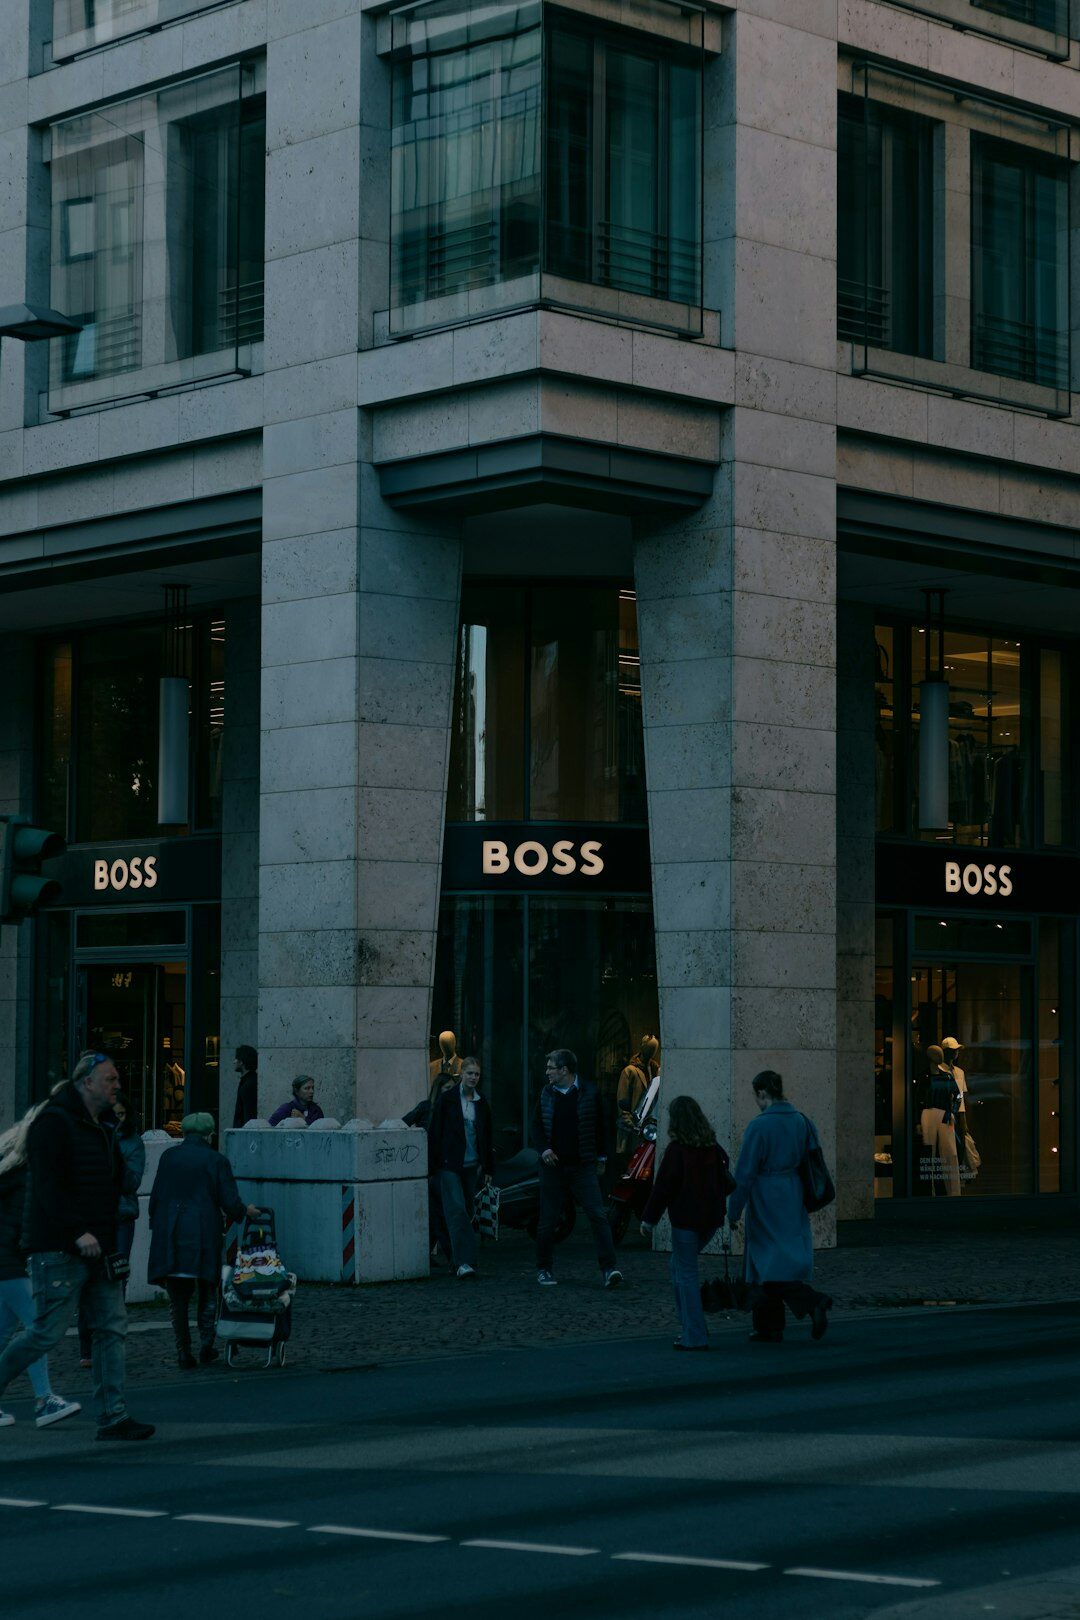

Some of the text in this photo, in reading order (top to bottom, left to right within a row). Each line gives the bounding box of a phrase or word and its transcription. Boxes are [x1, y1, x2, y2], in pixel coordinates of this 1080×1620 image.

[94, 856, 158, 891] BOSS
[482, 840, 604, 876] BOSS
[945, 861, 1013, 897] BOSS
